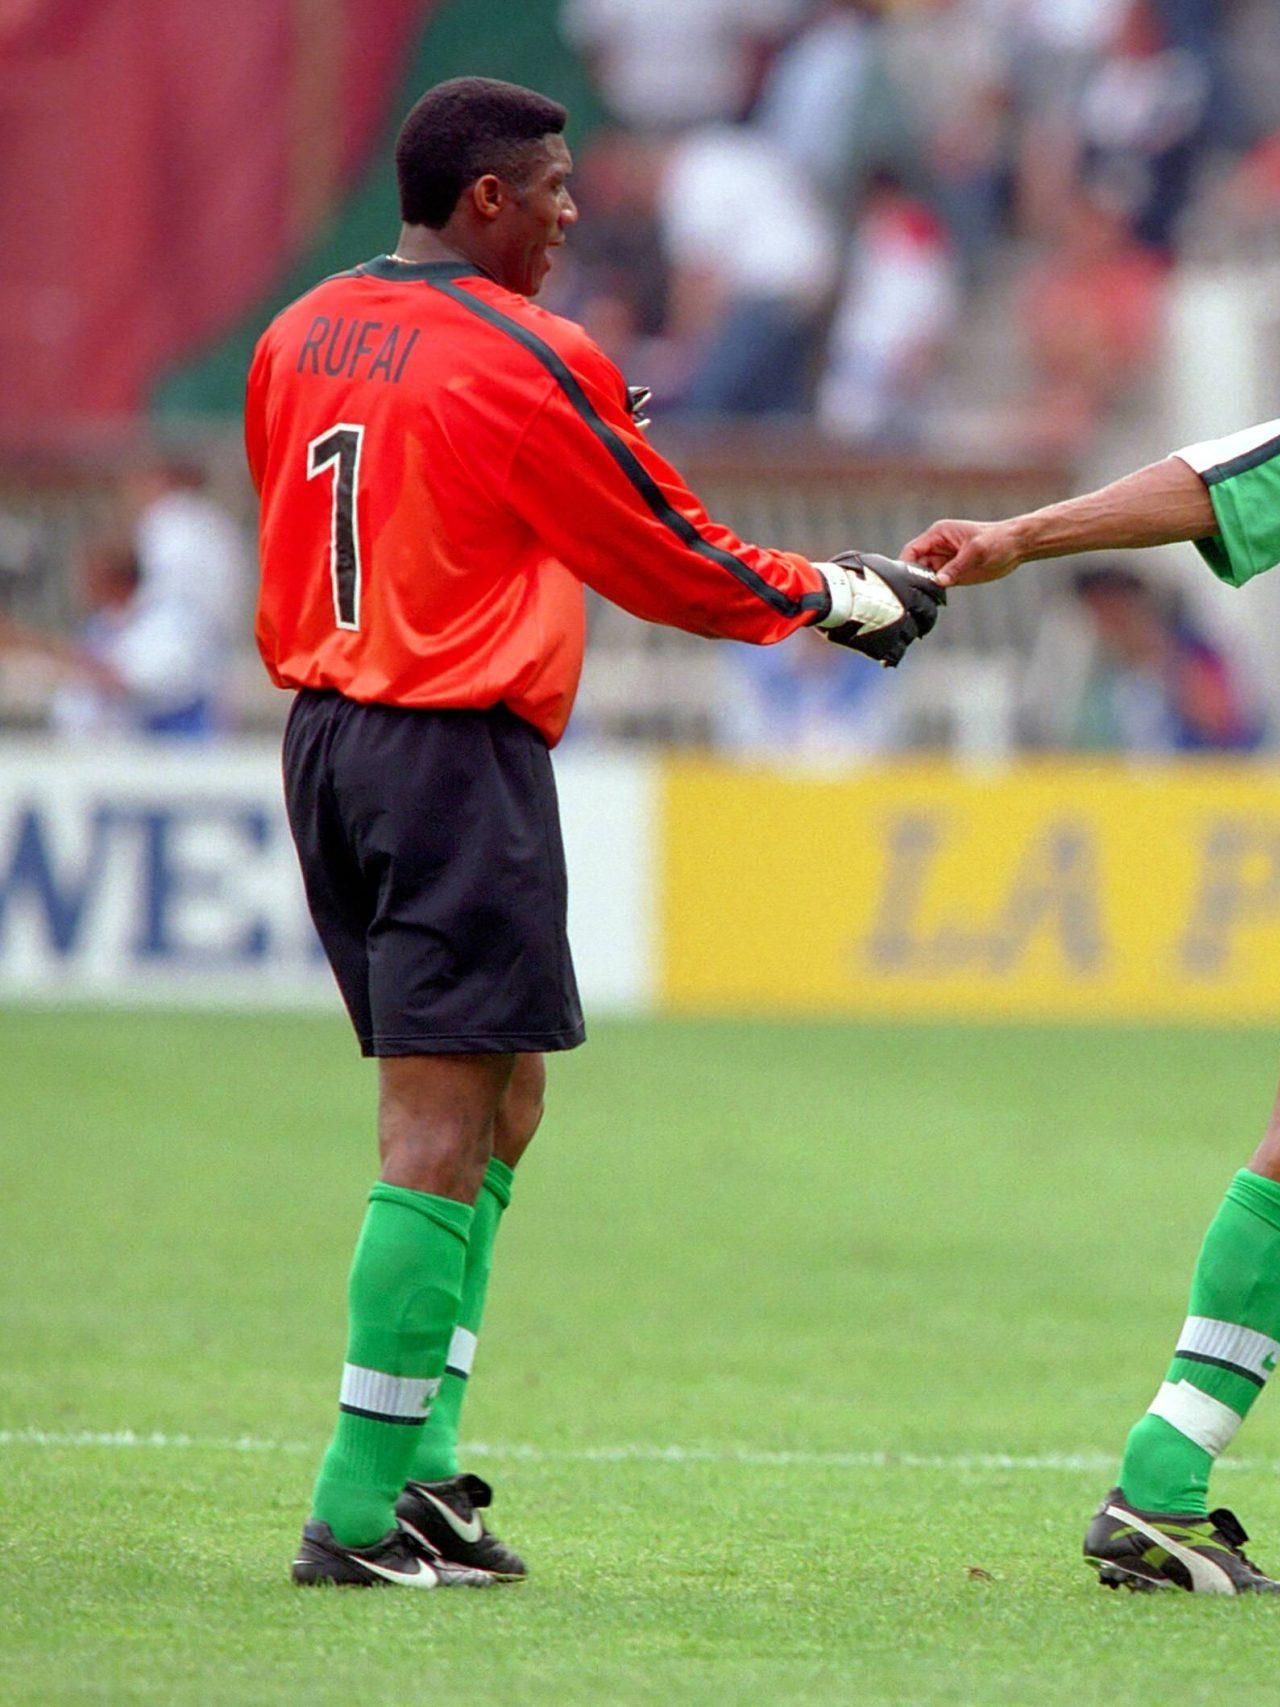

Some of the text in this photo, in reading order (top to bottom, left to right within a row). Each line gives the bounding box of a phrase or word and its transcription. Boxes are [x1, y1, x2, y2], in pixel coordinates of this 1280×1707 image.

[296, 315, 421, 384] RUFAI
[306, 422, 365, 632] 1
[0, 803, 326, 965] WE
[866, 818, 1107, 974] LA
